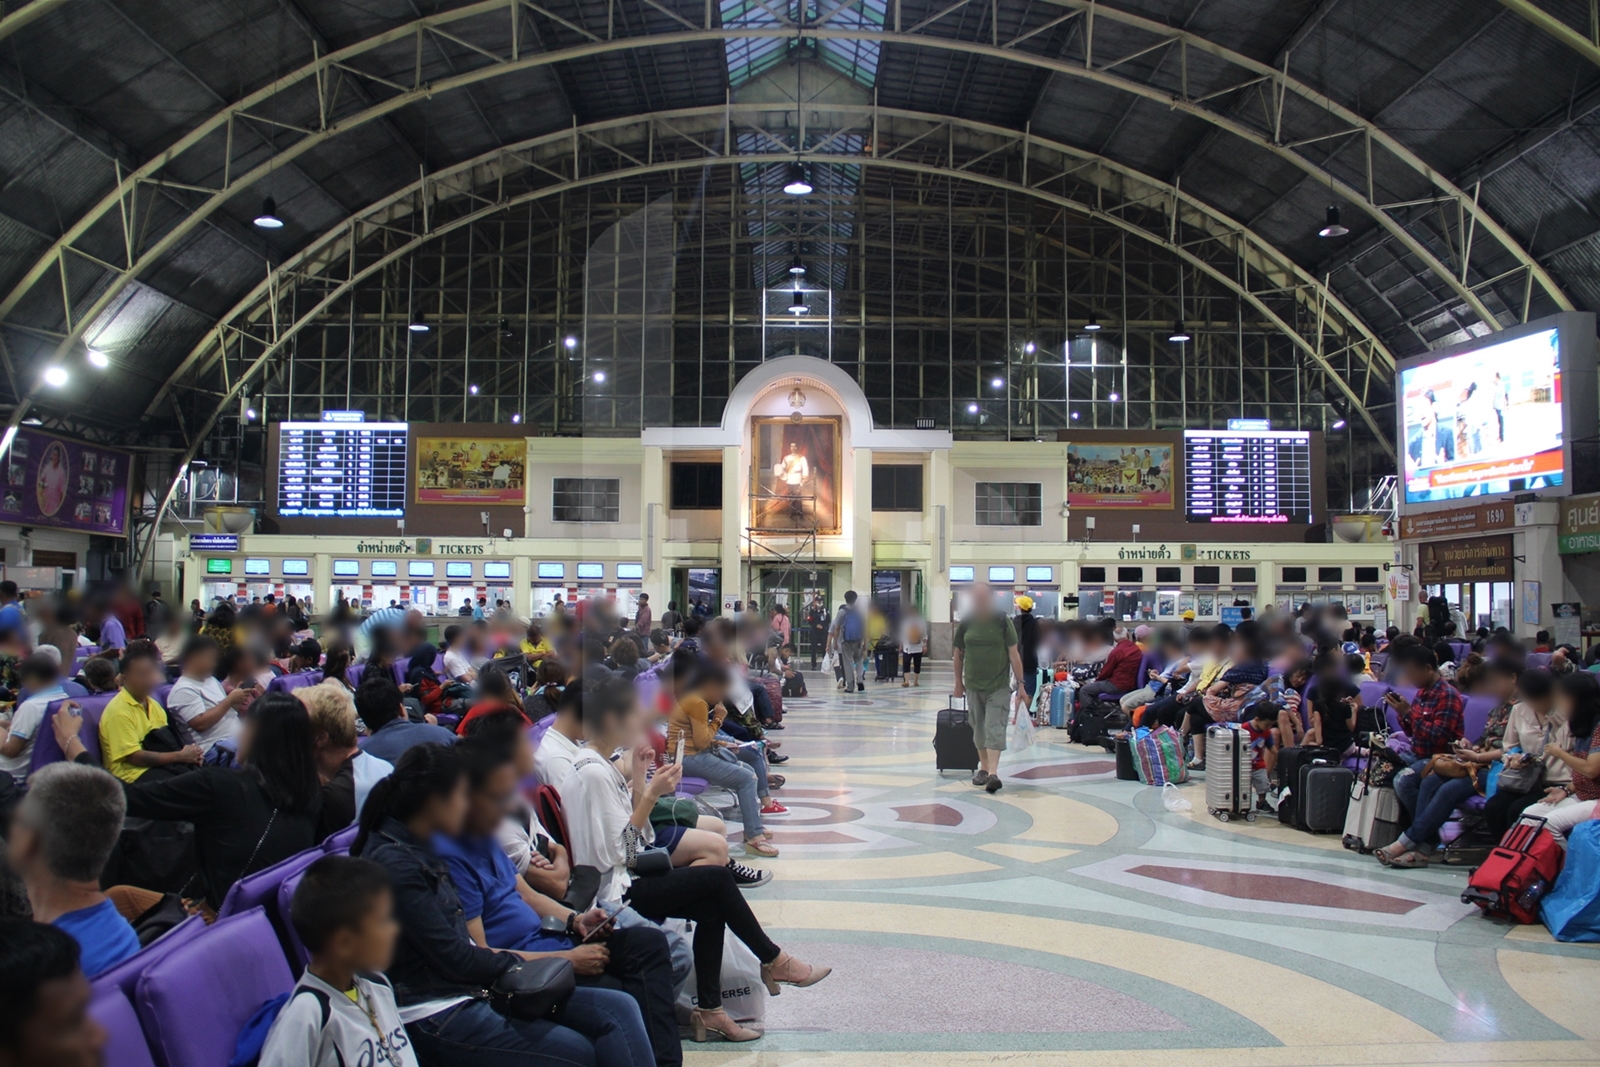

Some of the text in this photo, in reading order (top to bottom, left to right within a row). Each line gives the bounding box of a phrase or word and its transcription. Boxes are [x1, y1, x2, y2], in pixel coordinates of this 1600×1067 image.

[1486, 508, 1505, 524] 1690
[439, 544, 484, 555] TICKETS
[1117, 543, 1171, 560] จำหน่ายตั๋ว
[1207, 549, 1251, 560] TICKETS
[1445, 564, 1463, 578] Train
[1464, 563, 1506, 577] Information
[691, 986, 751, 1006] CERSE
